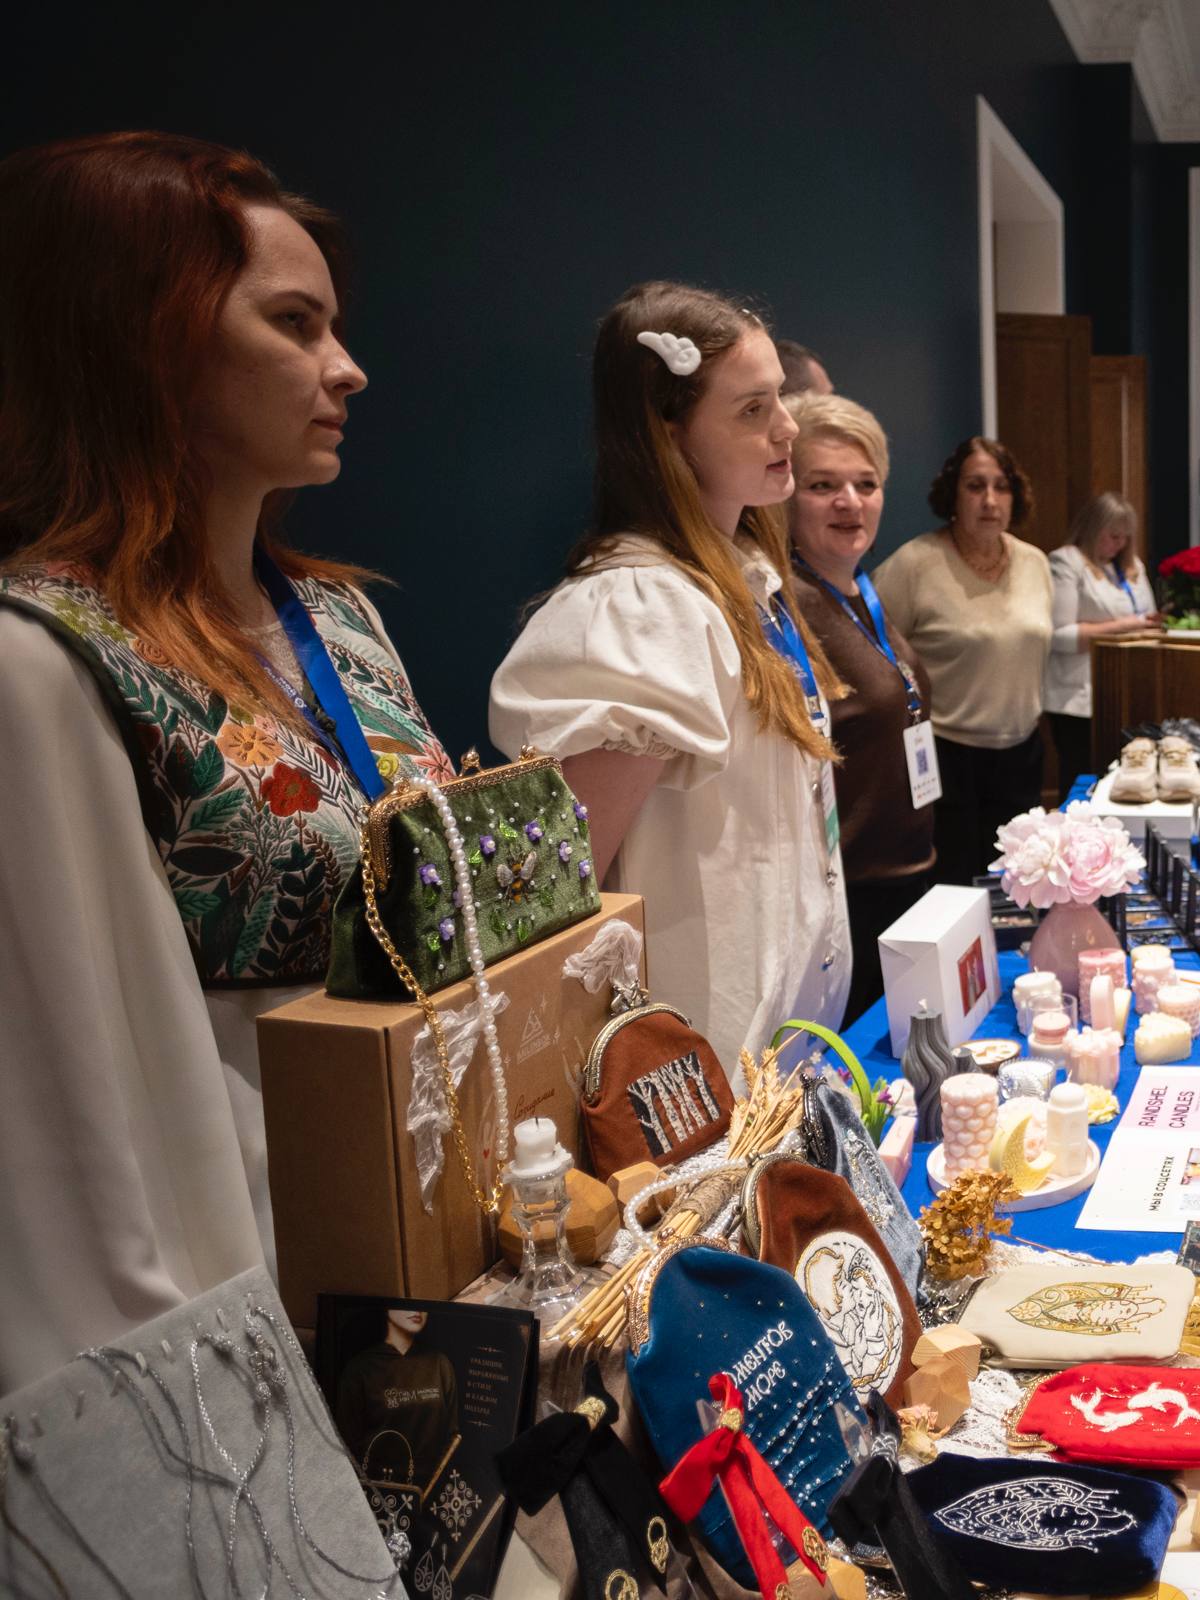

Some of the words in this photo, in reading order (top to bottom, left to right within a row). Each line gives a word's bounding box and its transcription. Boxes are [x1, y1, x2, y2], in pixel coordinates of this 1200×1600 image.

[1138, 1085, 1168, 1127] RANDSHEL
[1168, 1090, 1195, 1129] CANDLES
[1148, 1198, 1161, 1212] МЫ
[1156, 1156, 1175, 1191] СОЦСЕТЯХ
[744, 1360, 786, 1411] МОРЕ
